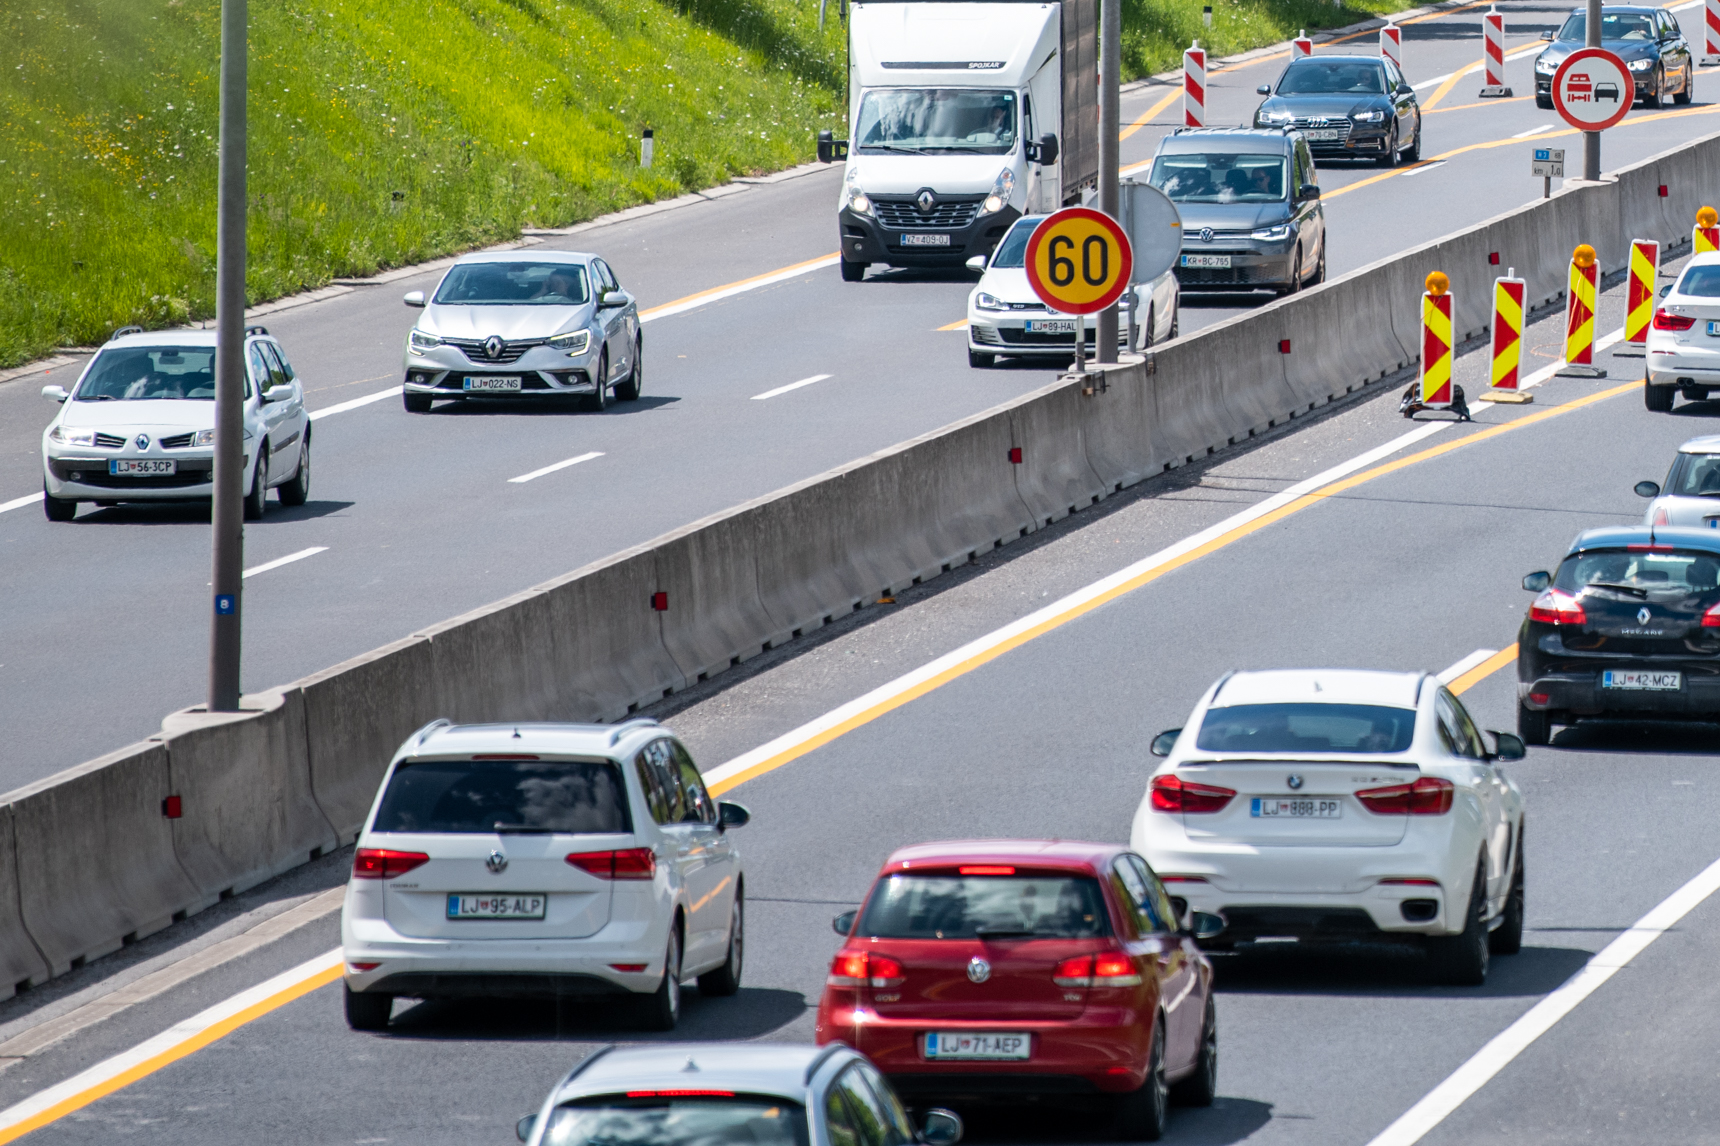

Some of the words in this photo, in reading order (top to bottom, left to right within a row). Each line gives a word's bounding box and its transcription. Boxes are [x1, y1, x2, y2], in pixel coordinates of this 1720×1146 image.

[906, 235, 915, 244] VZ
[1048, 235, 1108, 287] 60
[1187, 257, 1197, 265] KR
[1032, 322, 1043, 330] LJ
[1048, 322, 1077, 331] 89-HAL
[471, 379, 482, 388] LJ
[488, 379, 518, 389] 022-NS
[117, 461, 130, 472] LJ
[137, 461, 172, 472] 56-3CP
[1612, 674, 1626, 685] LJ
[1635, 675, 1677, 686] 42-MCZ
[1262, 802, 1279, 815] LJ
[461, 899, 479, 914] LJ
[490, 898, 540, 914] 95-ALP
[941, 1037, 959, 1053] LJ
[972, 1037, 1023, 1054] 71-AEP
